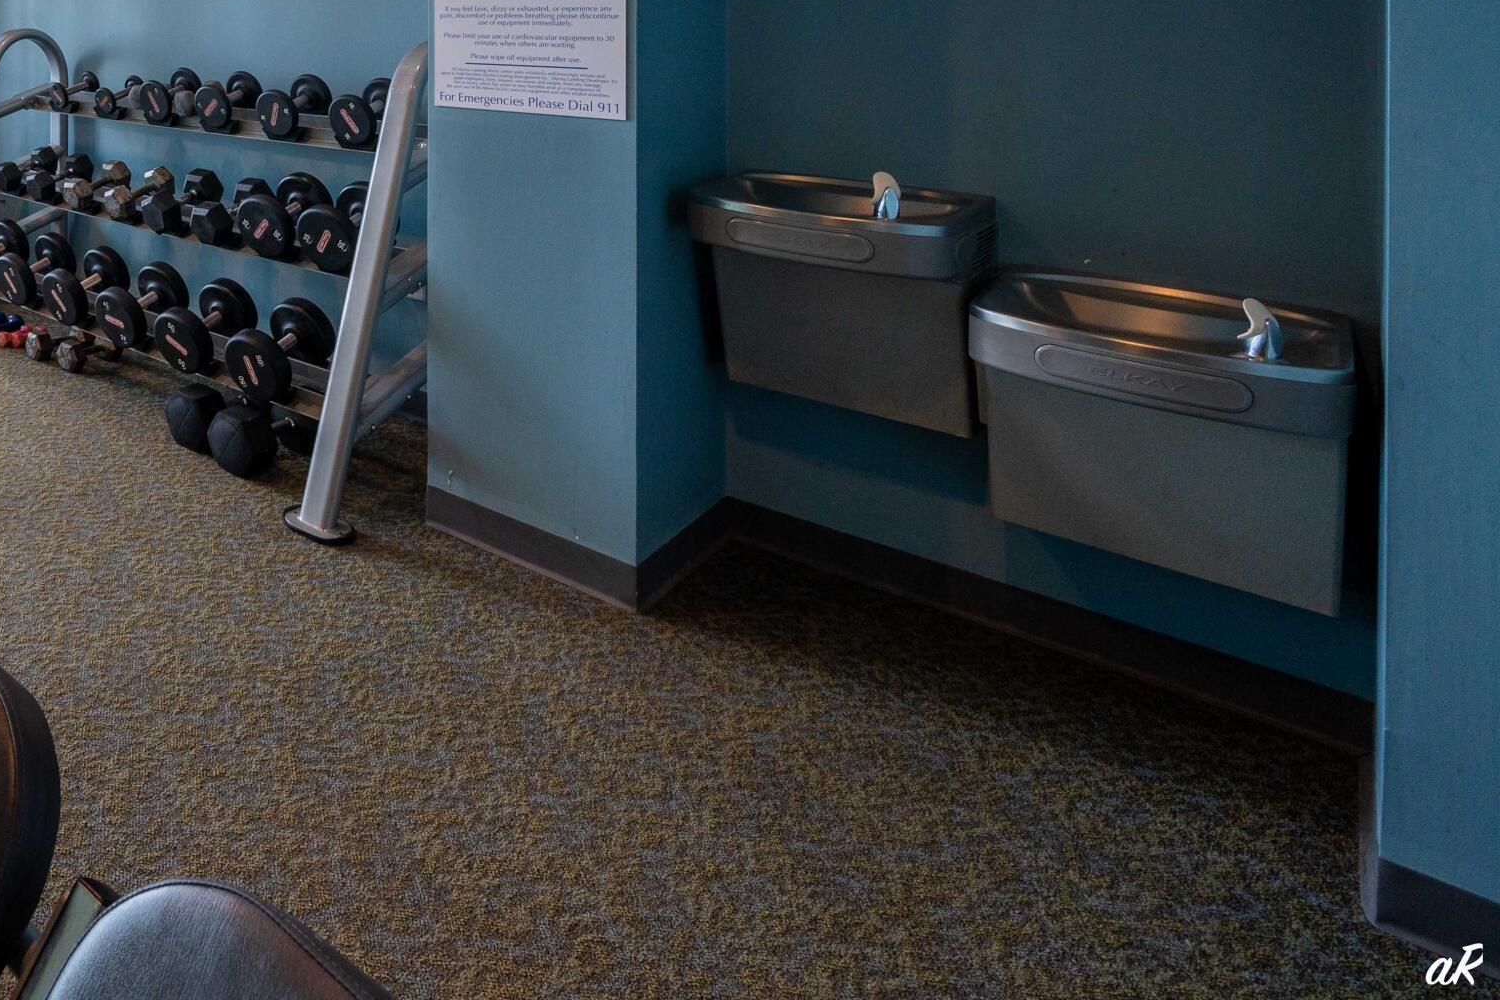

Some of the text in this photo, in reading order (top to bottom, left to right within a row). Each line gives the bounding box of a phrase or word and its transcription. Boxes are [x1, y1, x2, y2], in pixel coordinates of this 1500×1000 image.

[525, 13, 555, 21] breathing
[440, 91, 456, 102] For
[458, 92, 524, 108] Emergencies
[528, 97, 564, 110] Please
[568, 100, 593, 111] Dial
[597, 102, 619, 114] 911
